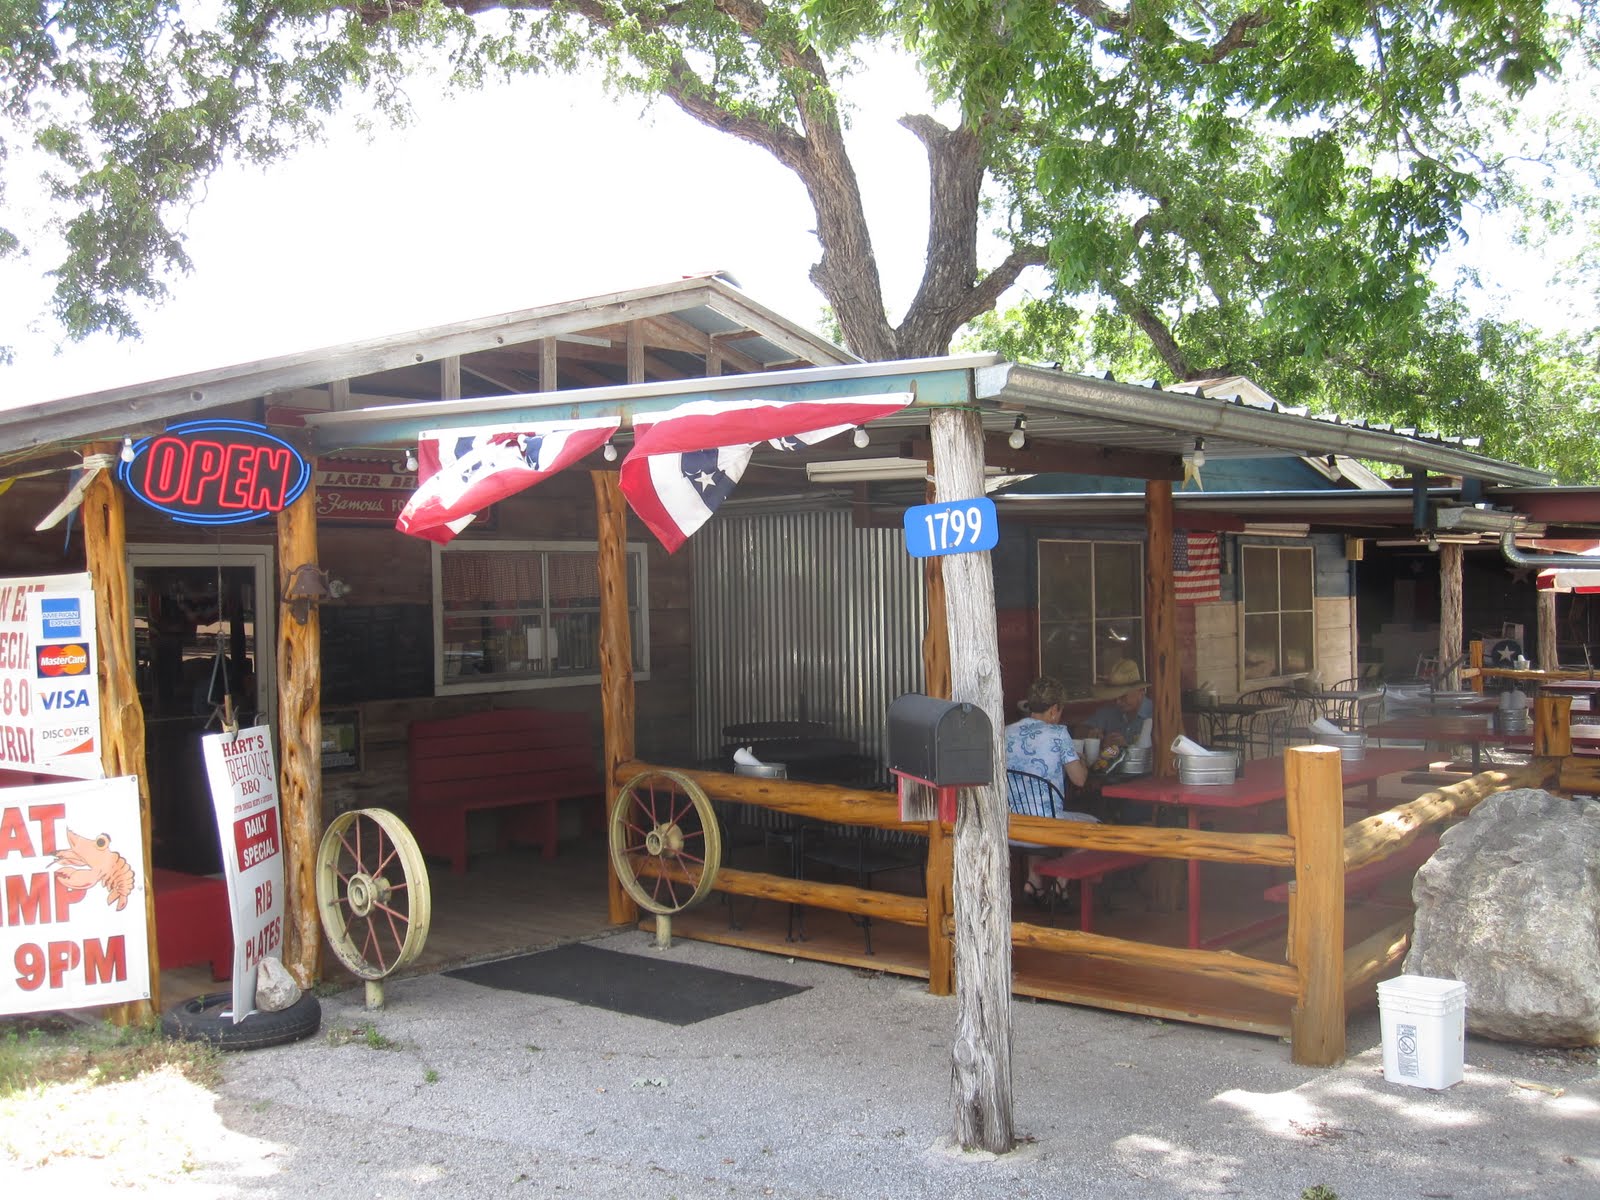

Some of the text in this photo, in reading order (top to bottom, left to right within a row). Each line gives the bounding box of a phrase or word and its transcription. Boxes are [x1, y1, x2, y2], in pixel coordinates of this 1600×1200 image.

[144, 437, 290, 511] OPEN
[324, 472, 381, 487] LAGER
[317, 492, 385, 515] Famous
[924, 506, 982, 551] 1799
[42, 611, 79, 619] AMERICAN
[40, 654, 87, 666] MasterCard
[37, 689, 90, 710] VISA
[42, 726, 89, 739] DISCOVER
[221, 734, 264, 757] HART'S
[241, 777, 260, 796] BBQ
[244, 813, 268, 839] DAILY
[243, 837, 275, 868] SPECIAL
[254, 879, 272, 918] RIB
[245, 916, 281, 973] PLATES
[14, 934, 128, 992] 9PM
